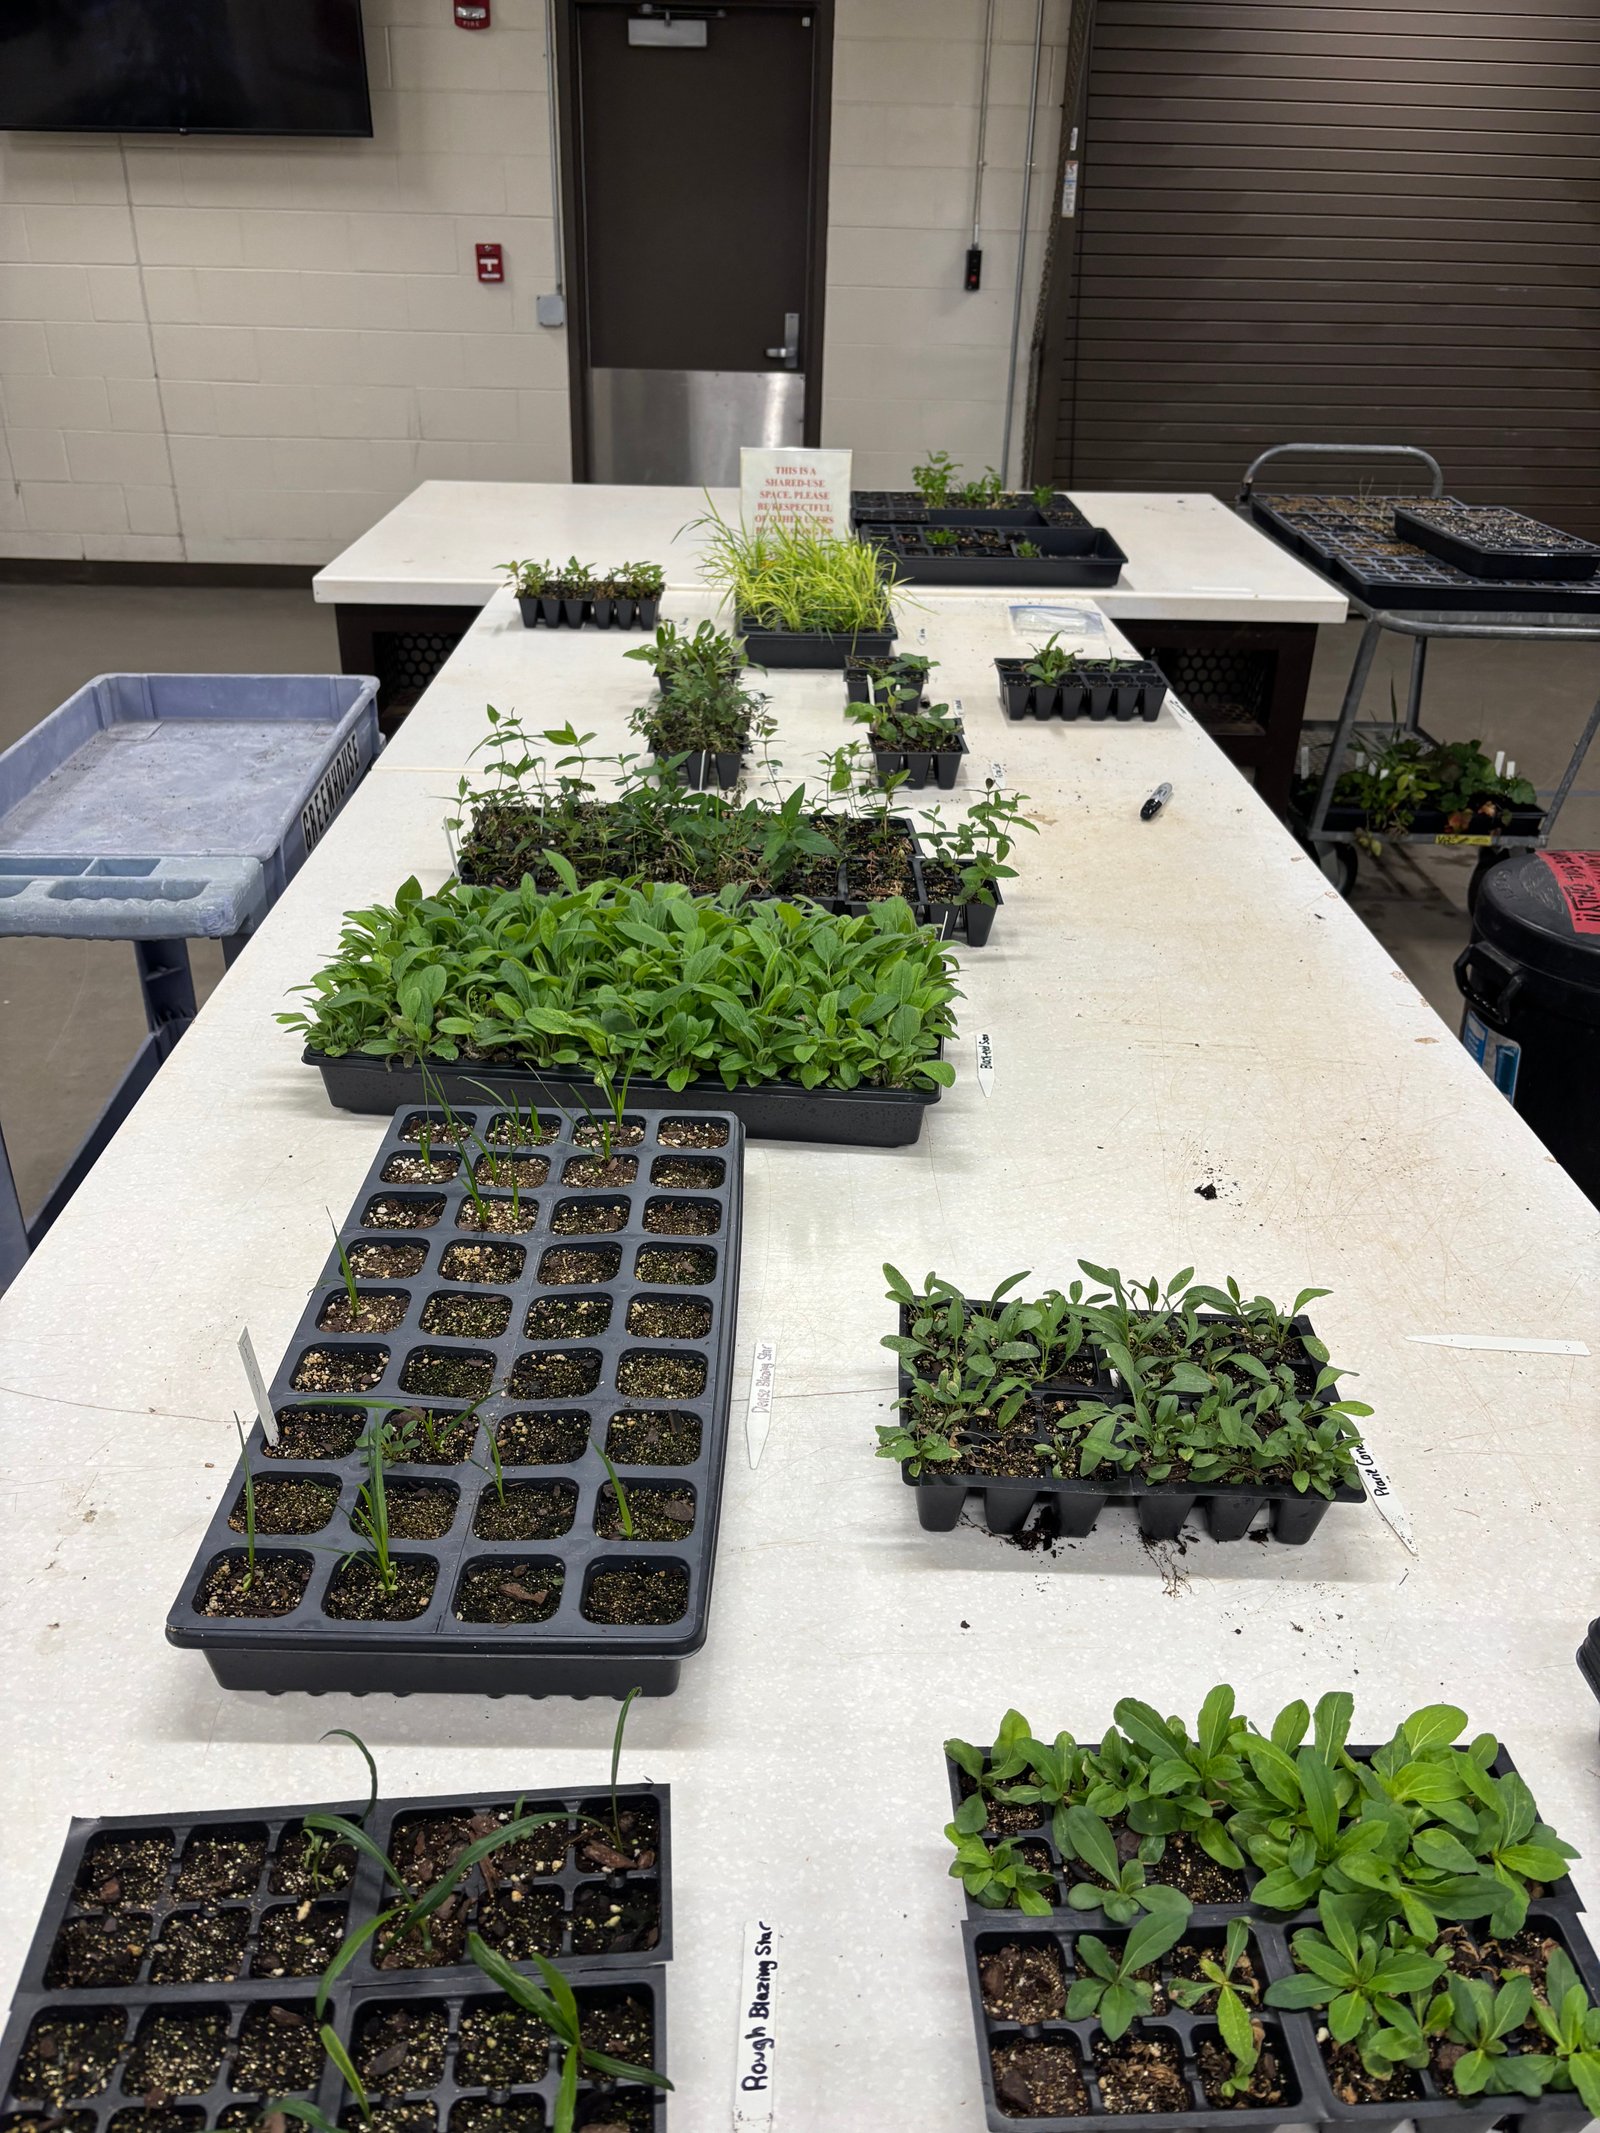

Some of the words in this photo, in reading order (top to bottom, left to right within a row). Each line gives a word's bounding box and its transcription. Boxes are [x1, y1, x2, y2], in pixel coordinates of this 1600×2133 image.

[765, 478, 826, 488] SHARED-USE
[775, 466, 798, 475] THIS
[799, 466, 807, 475] IS
[809, 467, 817, 476] A
[757, 502, 770, 512] BE
[772, 503, 833, 512] RESPECTFUL
[794, 491, 831, 500] PLEASE
[302, 733, 360, 854] GREENHOUSE
[756, 1343, 772, 1361] Star
[755, 1363, 775, 1388] Blazing
[751, 1388, 771, 1414] Dense
[754, 1920, 773, 1956] Star
[748, 1960, 779, 2020] Blazing
[740, 2026, 775, 2092] Rough
